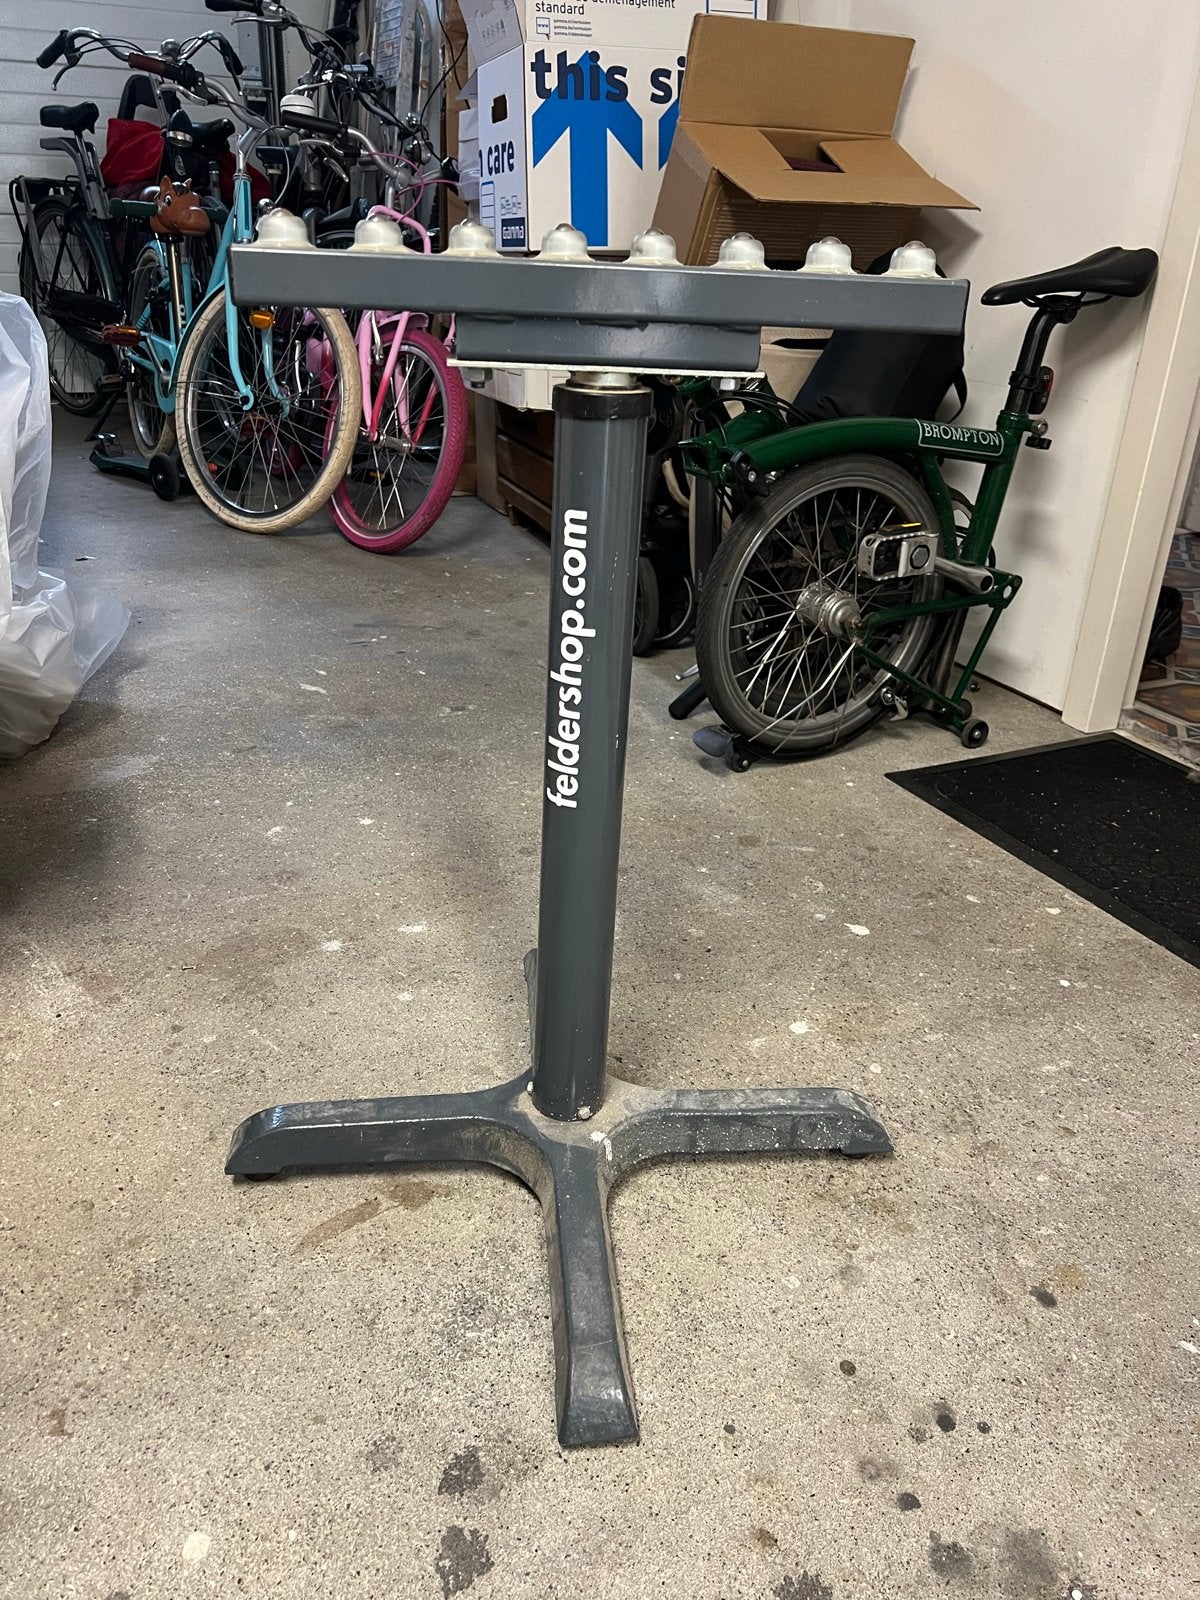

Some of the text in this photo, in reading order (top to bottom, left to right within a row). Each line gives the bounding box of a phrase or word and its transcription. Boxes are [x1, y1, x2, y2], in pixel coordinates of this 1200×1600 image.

[535, 1, 585, 15] standard
[530, 48, 686, 105] this si
[487, 140, 515, 176] care
[922, 422, 1000, 447] BROMPTON
[546, 508, 597, 809] feldershop.com
